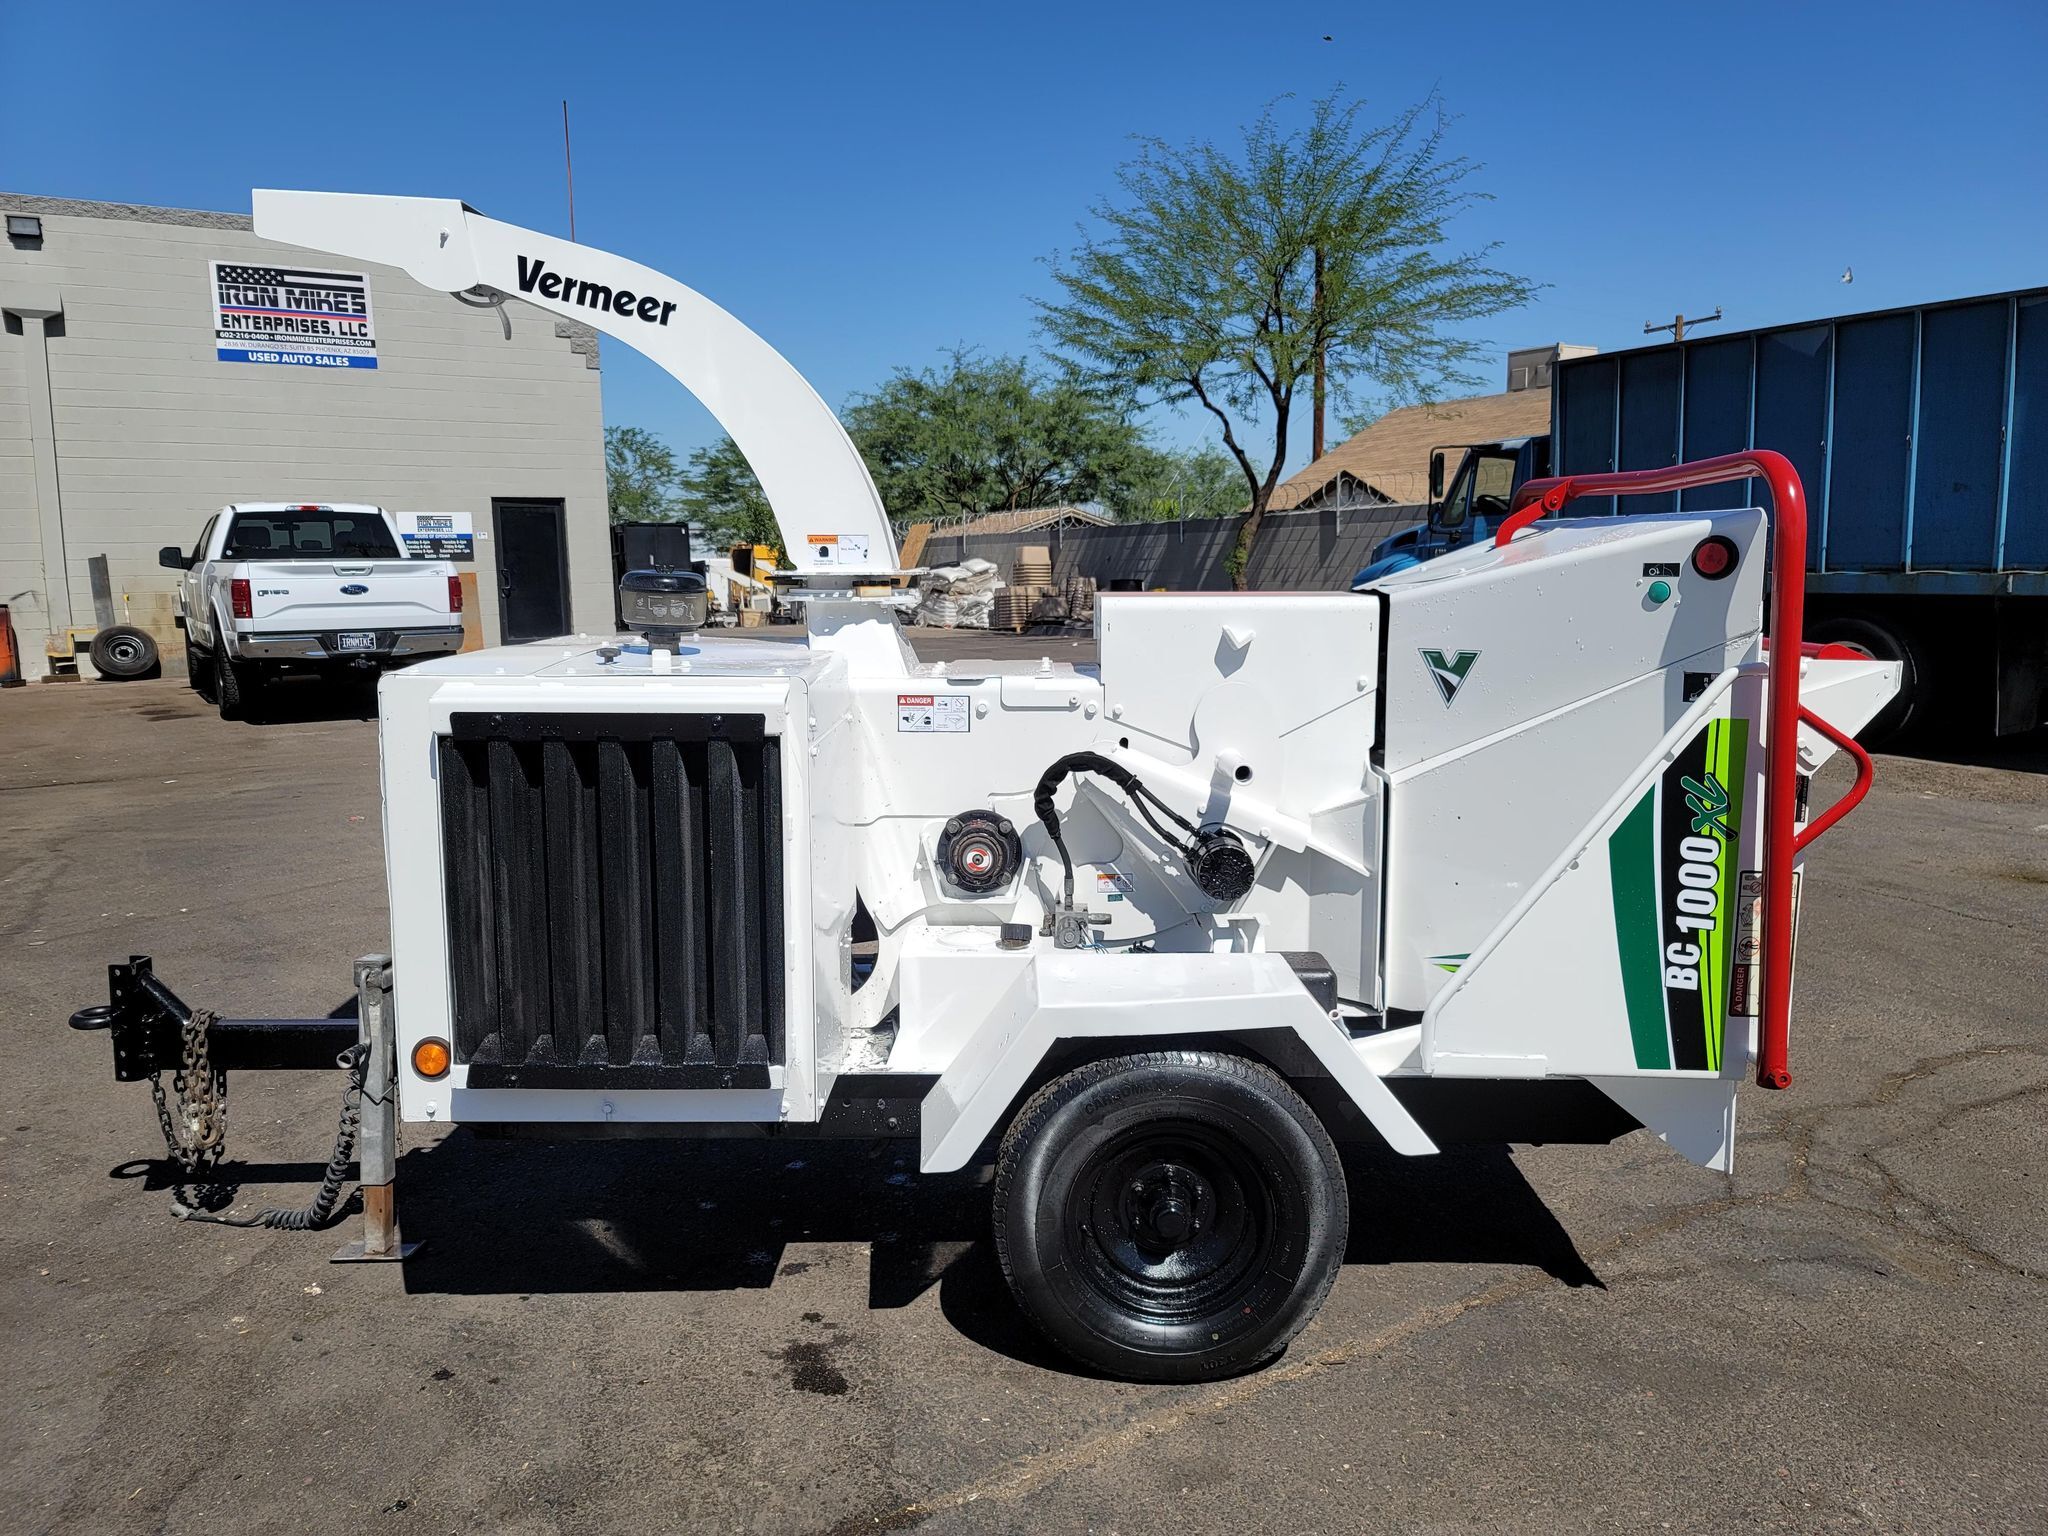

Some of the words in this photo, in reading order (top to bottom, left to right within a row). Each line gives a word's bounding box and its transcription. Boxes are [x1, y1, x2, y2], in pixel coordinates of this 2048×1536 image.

[218, 284, 279, 308] IRON
[285, 289, 367, 314] MIKES
[517, 255, 677, 326] Vermeer
[221, 314, 335, 336] ENTERPRISES,
[339, 321, 368, 337] LLC
[219, 331, 270, 341] 602-216-0400
[274, 334, 372, 347] IRONMIKEENTERPRISES.COM
[248, 342, 279, 350] DURANGO
[248, 352, 279, 362] USED
[281, 354, 314, 364] AUTO
[315, 356, 349, 366] SALES
[342, 637, 373, 648] IRNMIKE
[1675, 836, 1720, 933] 1000
[1665, 942, 1700, 990] BC
[1734, 967, 1745, 1002] DANGER
